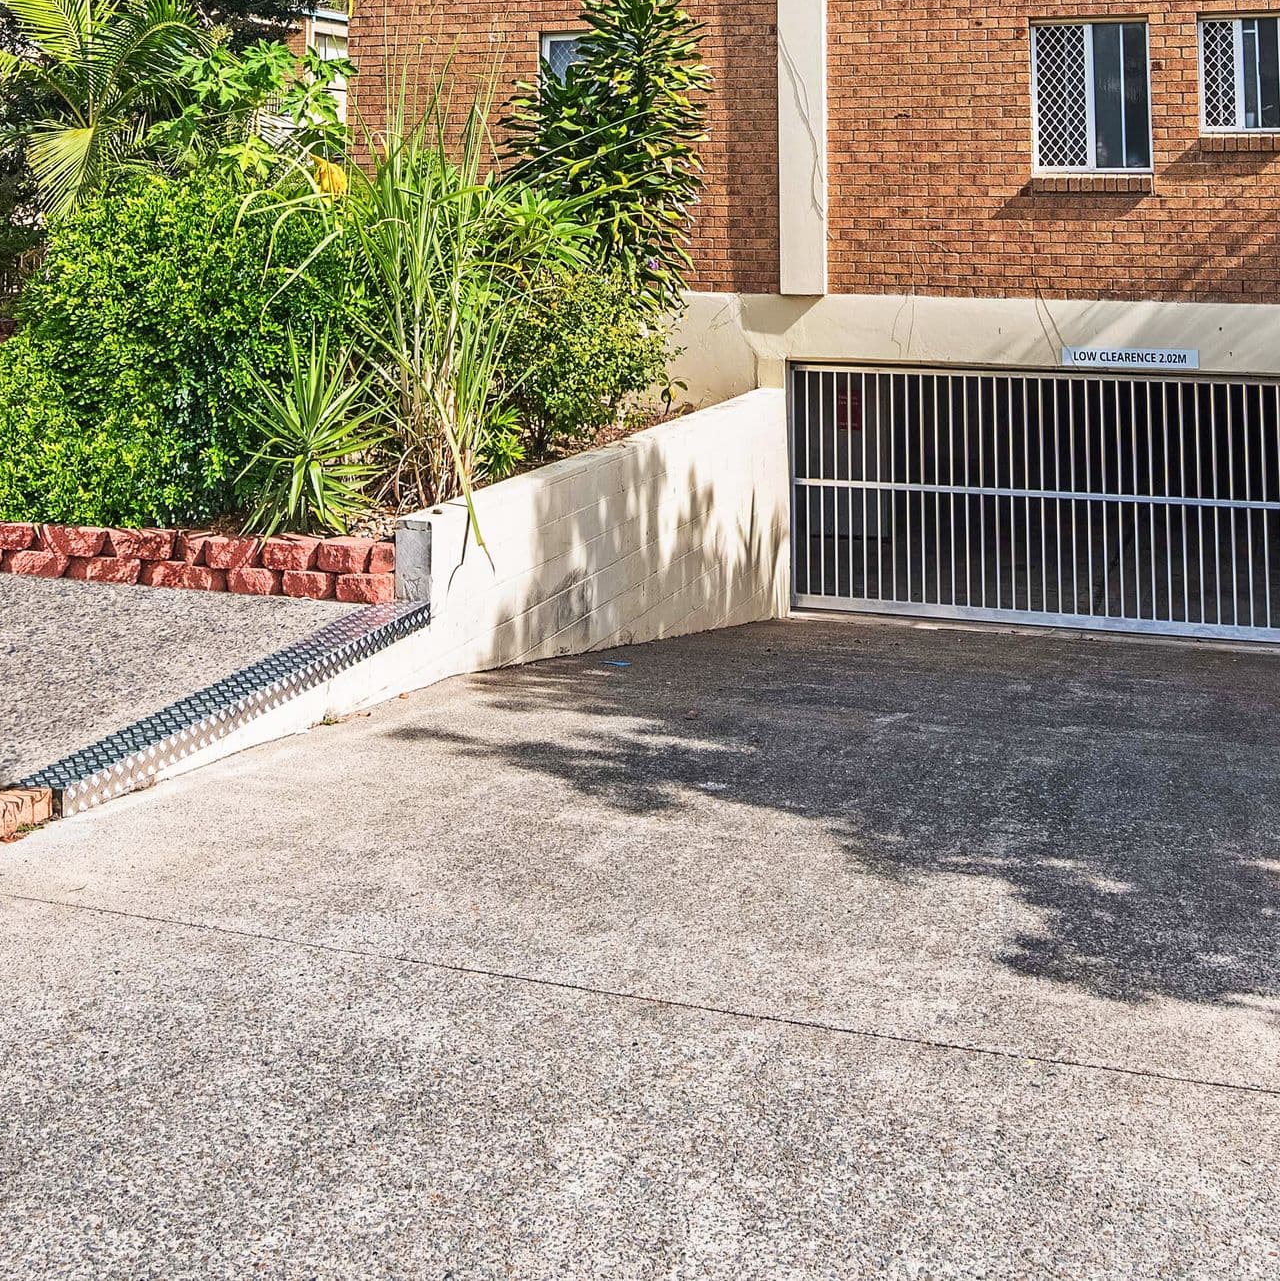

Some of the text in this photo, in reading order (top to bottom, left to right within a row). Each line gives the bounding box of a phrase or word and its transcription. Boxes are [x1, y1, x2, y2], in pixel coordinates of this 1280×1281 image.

[1073, 351, 1187, 364] LOW CLEARENCE 2.02M
